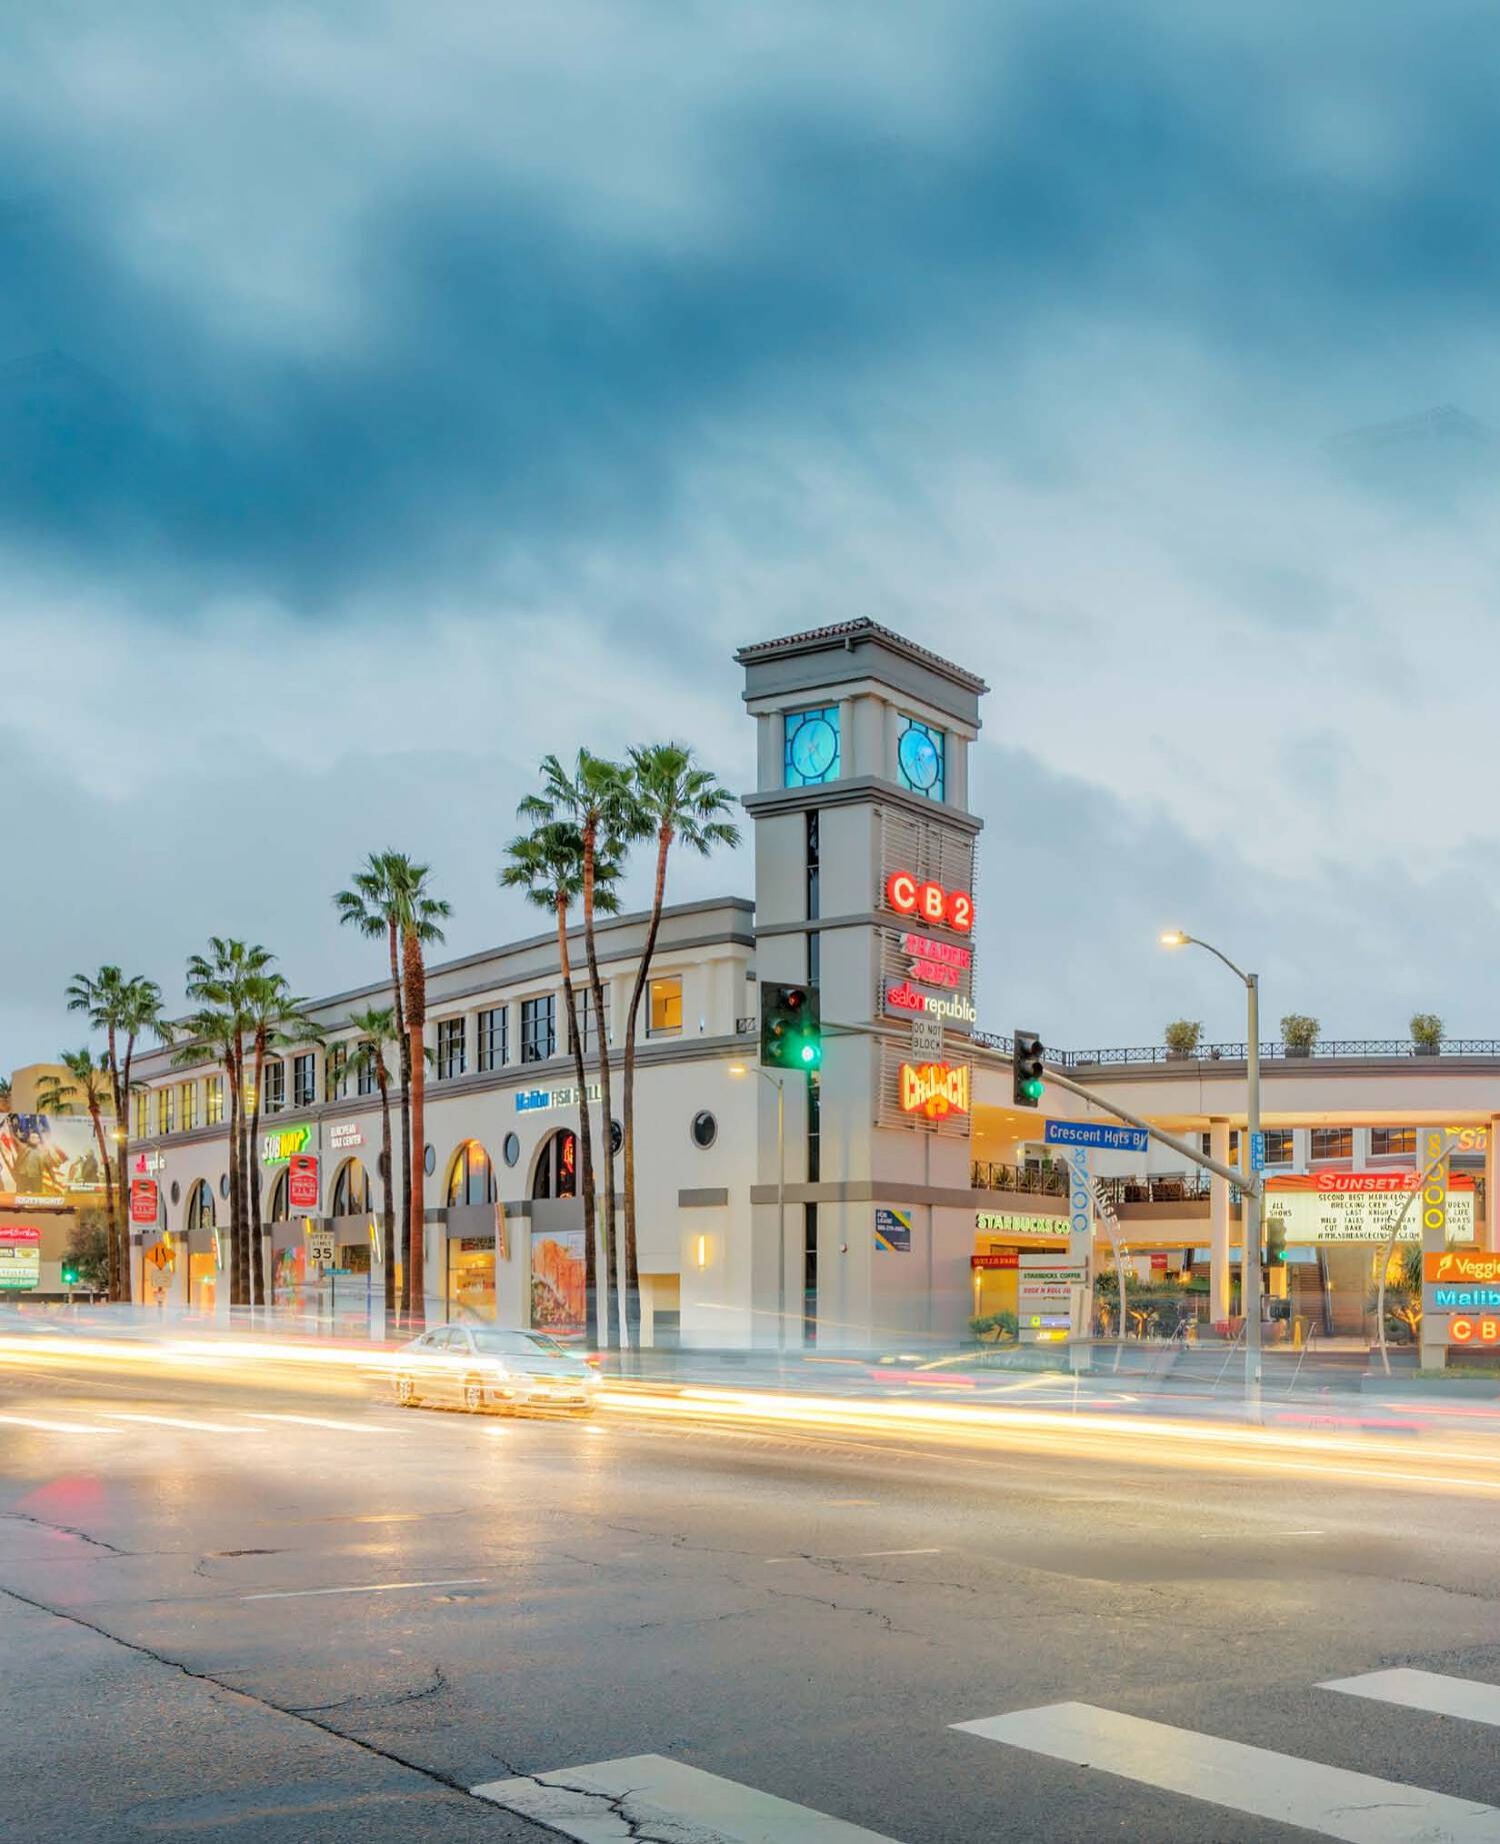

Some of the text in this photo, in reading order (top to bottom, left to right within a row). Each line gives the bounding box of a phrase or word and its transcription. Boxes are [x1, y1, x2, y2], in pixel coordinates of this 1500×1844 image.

[903, 1063, 968, 1113] CRUNCH
[262, 1129, 304, 1160] SUBWAY
[1050, 1125, 1101, 1142] Crescent
[1104, 1130, 1129, 1147] Hgts
[977, 1212, 1053, 1233] STARBUCKS
[312, 1247, 332, 1259] 35
